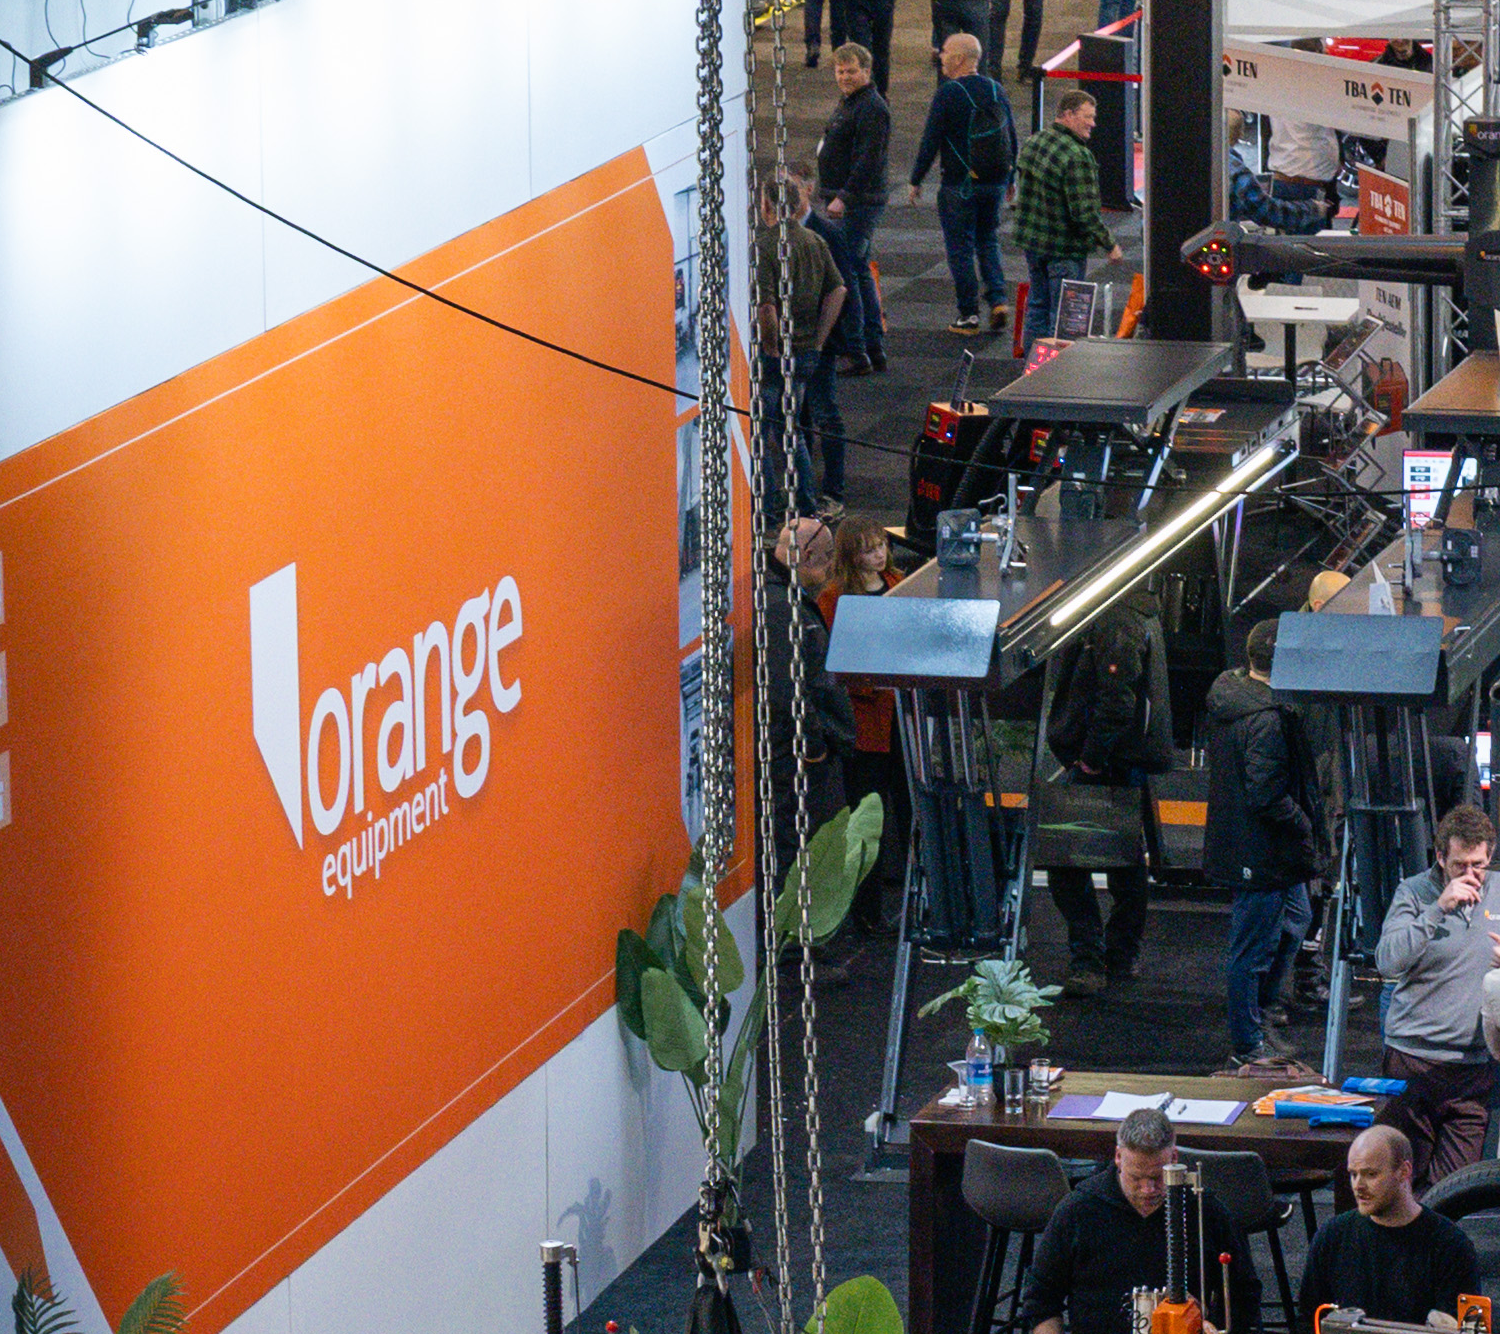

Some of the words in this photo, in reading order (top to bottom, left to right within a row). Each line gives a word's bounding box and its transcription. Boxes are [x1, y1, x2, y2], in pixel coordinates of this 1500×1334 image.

[1236, 59, 1258, 79] TEN
[1344, 80, 1368, 100] TBA
[1389, 88, 1411, 108] TEN
[306, 575, 523, 836] orange
[322, 769, 450, 899] equipment
